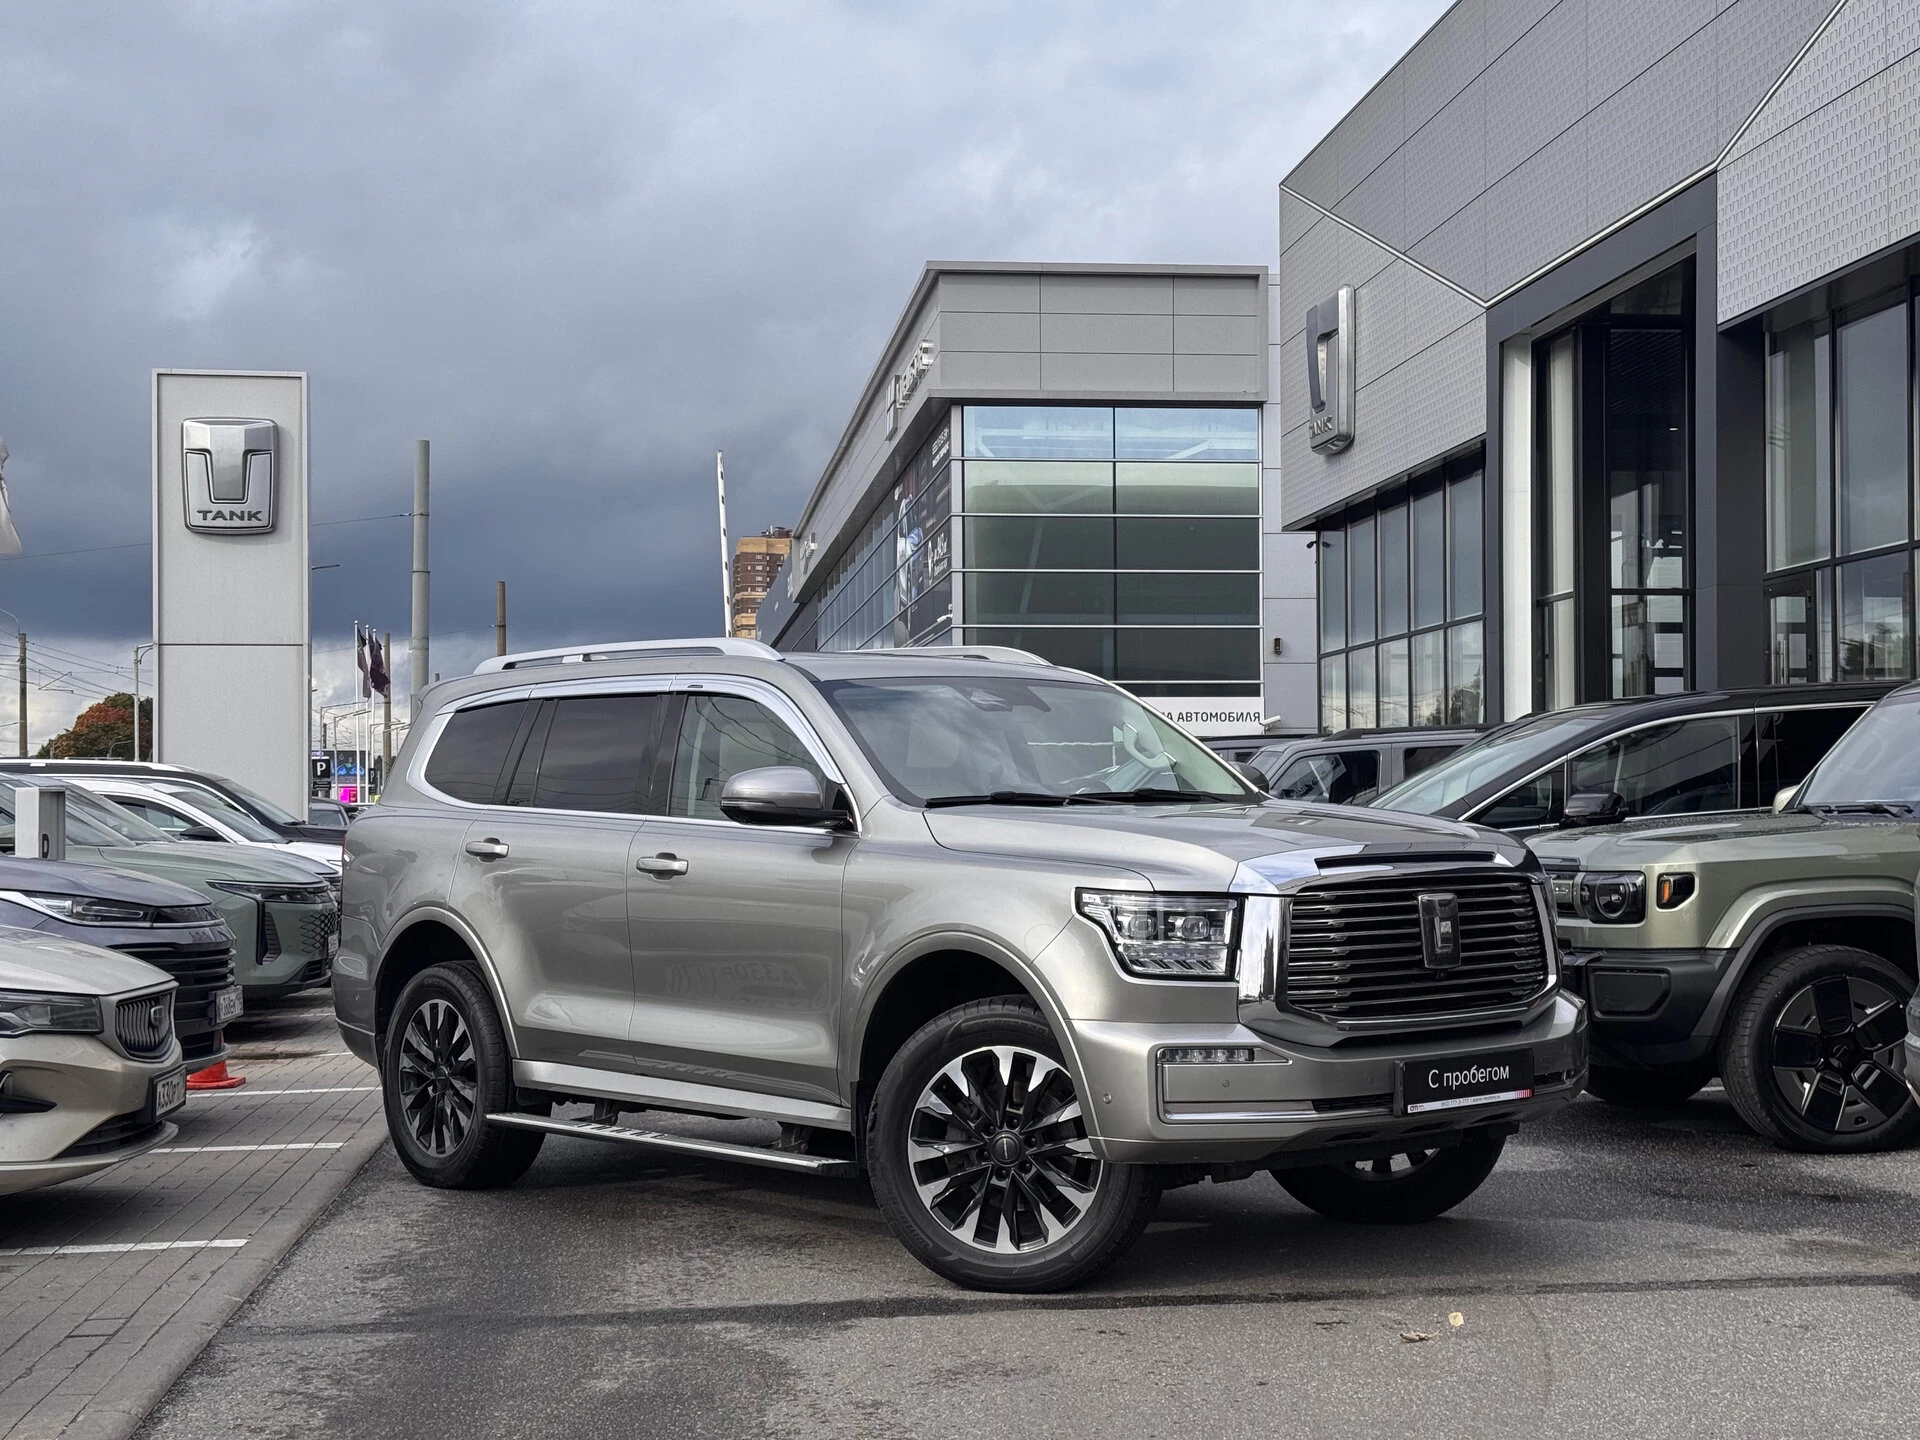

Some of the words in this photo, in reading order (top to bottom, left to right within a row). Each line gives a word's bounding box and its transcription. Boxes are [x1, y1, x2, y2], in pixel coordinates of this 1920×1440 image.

[1309, 415, 1333, 439] ANK
[196, 509, 263, 522] TANK
[1177, 711, 1261, 723] АВТОМОБИЛЯ
[316, 761, 327, 776] P
[1428, 1069, 1439, 1088] С
[1443, 1065, 1510, 1090] пробегом
